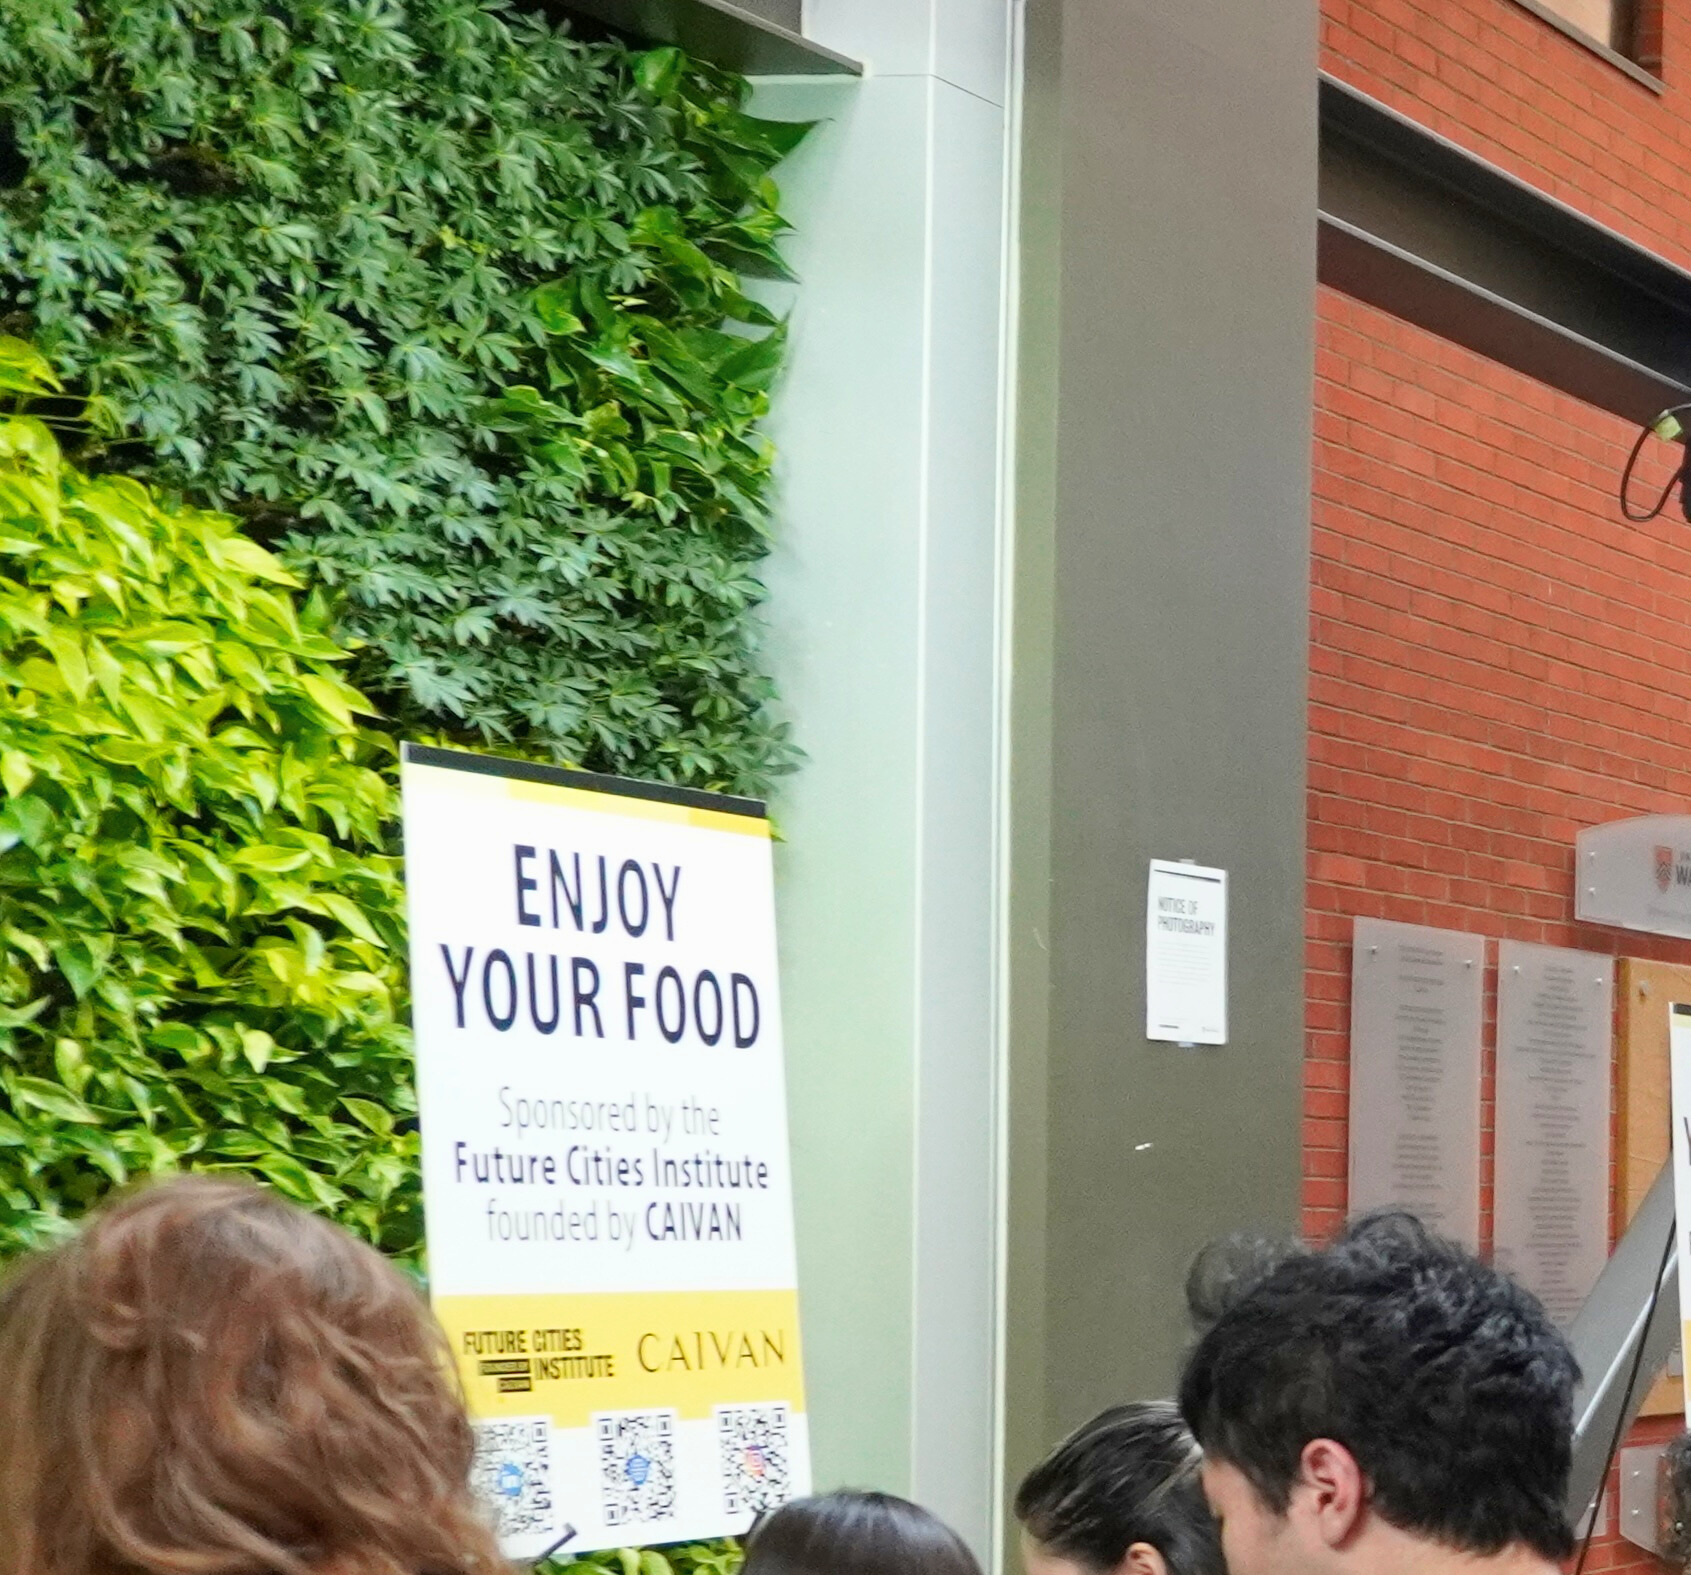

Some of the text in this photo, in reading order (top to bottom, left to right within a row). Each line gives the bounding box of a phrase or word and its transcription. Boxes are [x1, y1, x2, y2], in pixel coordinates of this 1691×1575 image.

[513, 843, 681, 941] ENJOY
[1158, 896, 1198, 916] NOTICE OF
[1157, 915, 1215, 936] PHOTOGRAPHY
[439, 943, 761, 1049] YOUR FOOD
[499, 1086, 720, 1144] Sponsored by the
[455, 1141, 769, 1188] Future Cities Institute
[486, 1198, 742, 1252] founded by CAIVAN
[463, 1328, 583, 1354] FUTURE CITIES
[638, 1328, 786, 1373] CAIVAN
[534, 1355, 614, 1380] INSTITUTE
